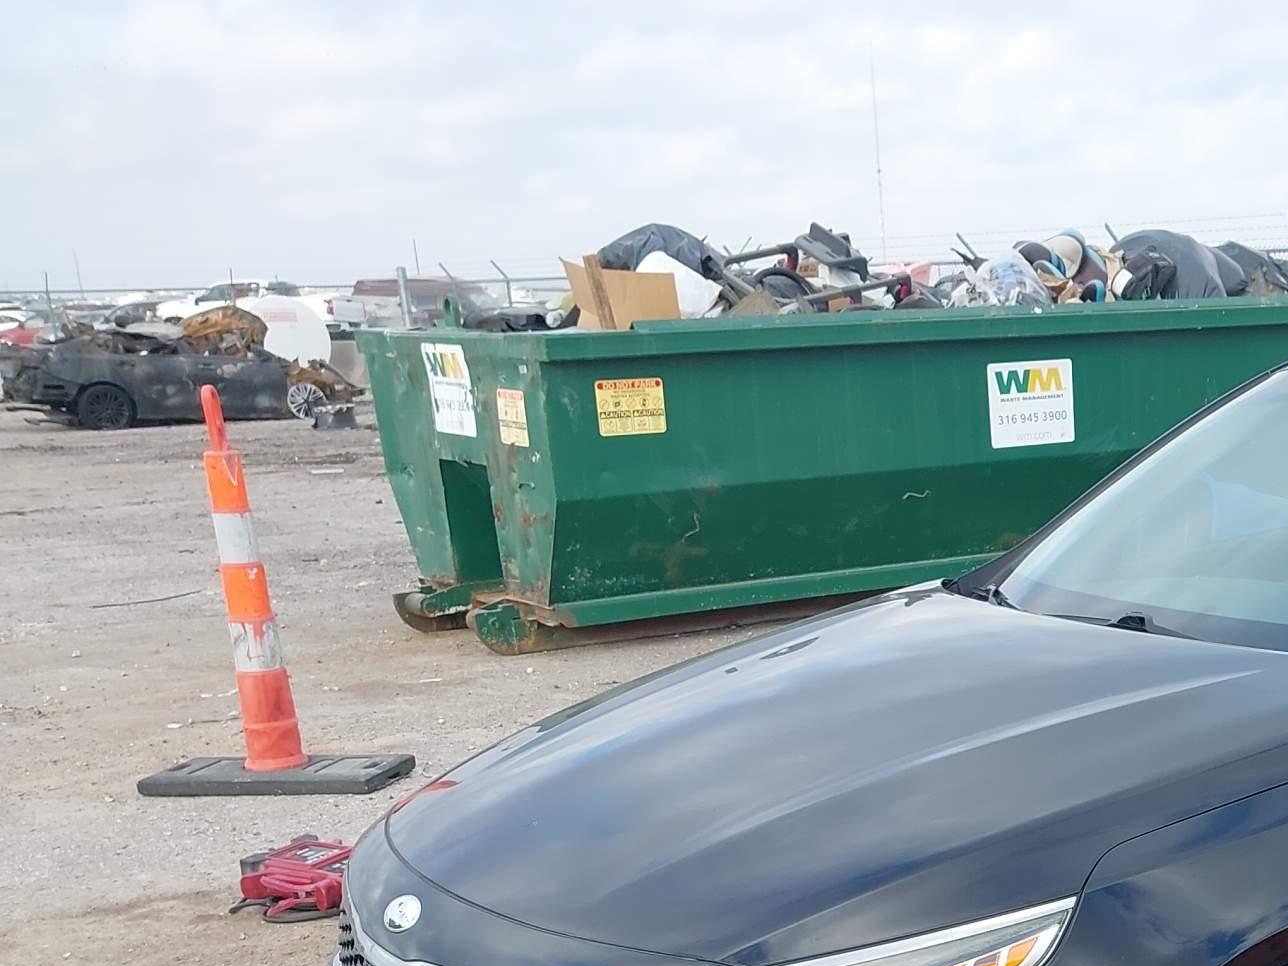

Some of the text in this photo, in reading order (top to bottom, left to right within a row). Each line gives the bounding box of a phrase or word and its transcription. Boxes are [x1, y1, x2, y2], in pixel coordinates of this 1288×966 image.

[635, 380, 655, 388] PARK
[995, 367, 1063, 395] WM
[998, 410, 1068, 425] 316 945 3900
[1016, 432, 1052, 441] wm.com
